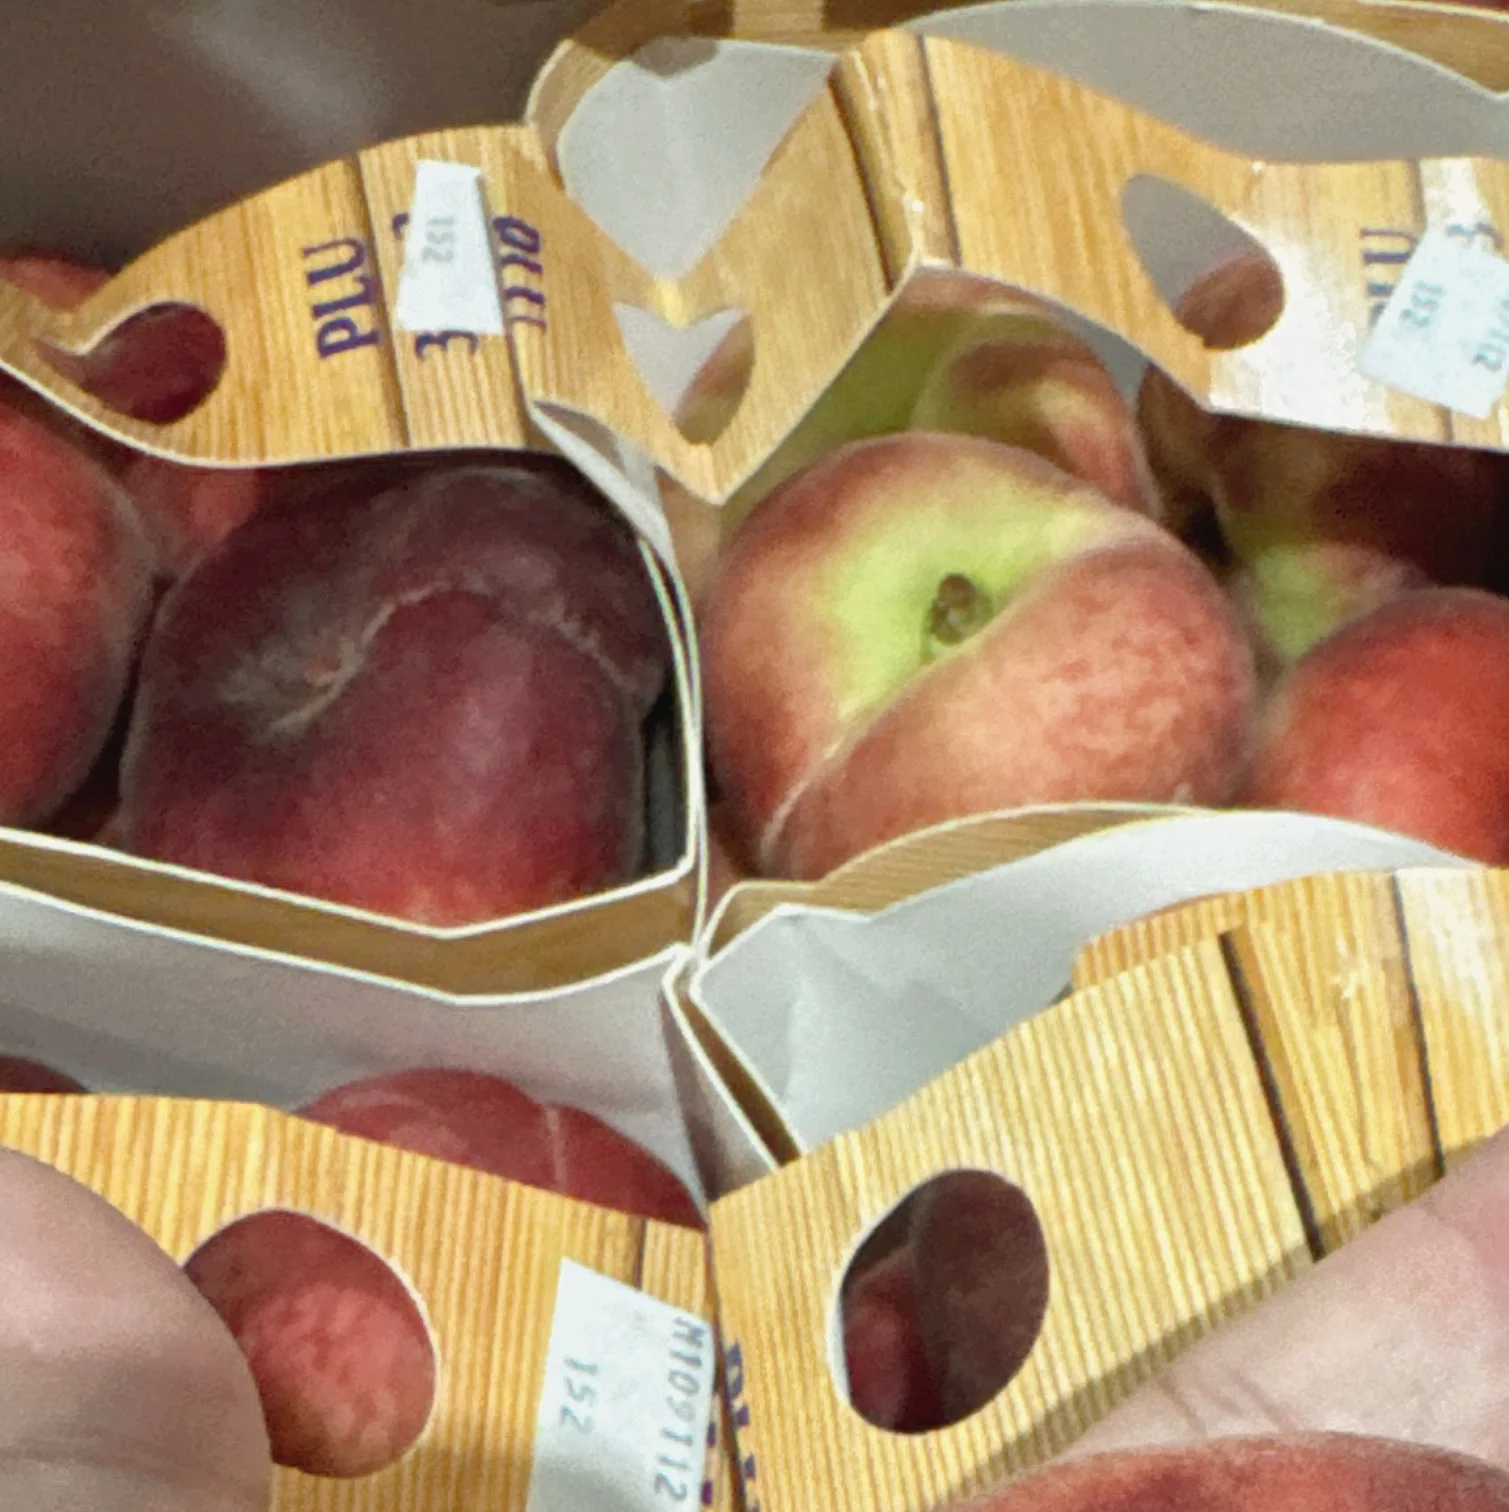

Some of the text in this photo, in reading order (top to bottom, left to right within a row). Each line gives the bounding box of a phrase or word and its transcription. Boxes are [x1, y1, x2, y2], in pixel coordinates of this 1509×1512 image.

[421, 216, 456, 262] 152
[301, 236, 379, 360] PLU
[559, 1357, 599, 1436] 152
[654, 1315, 707, 1503] M109112
